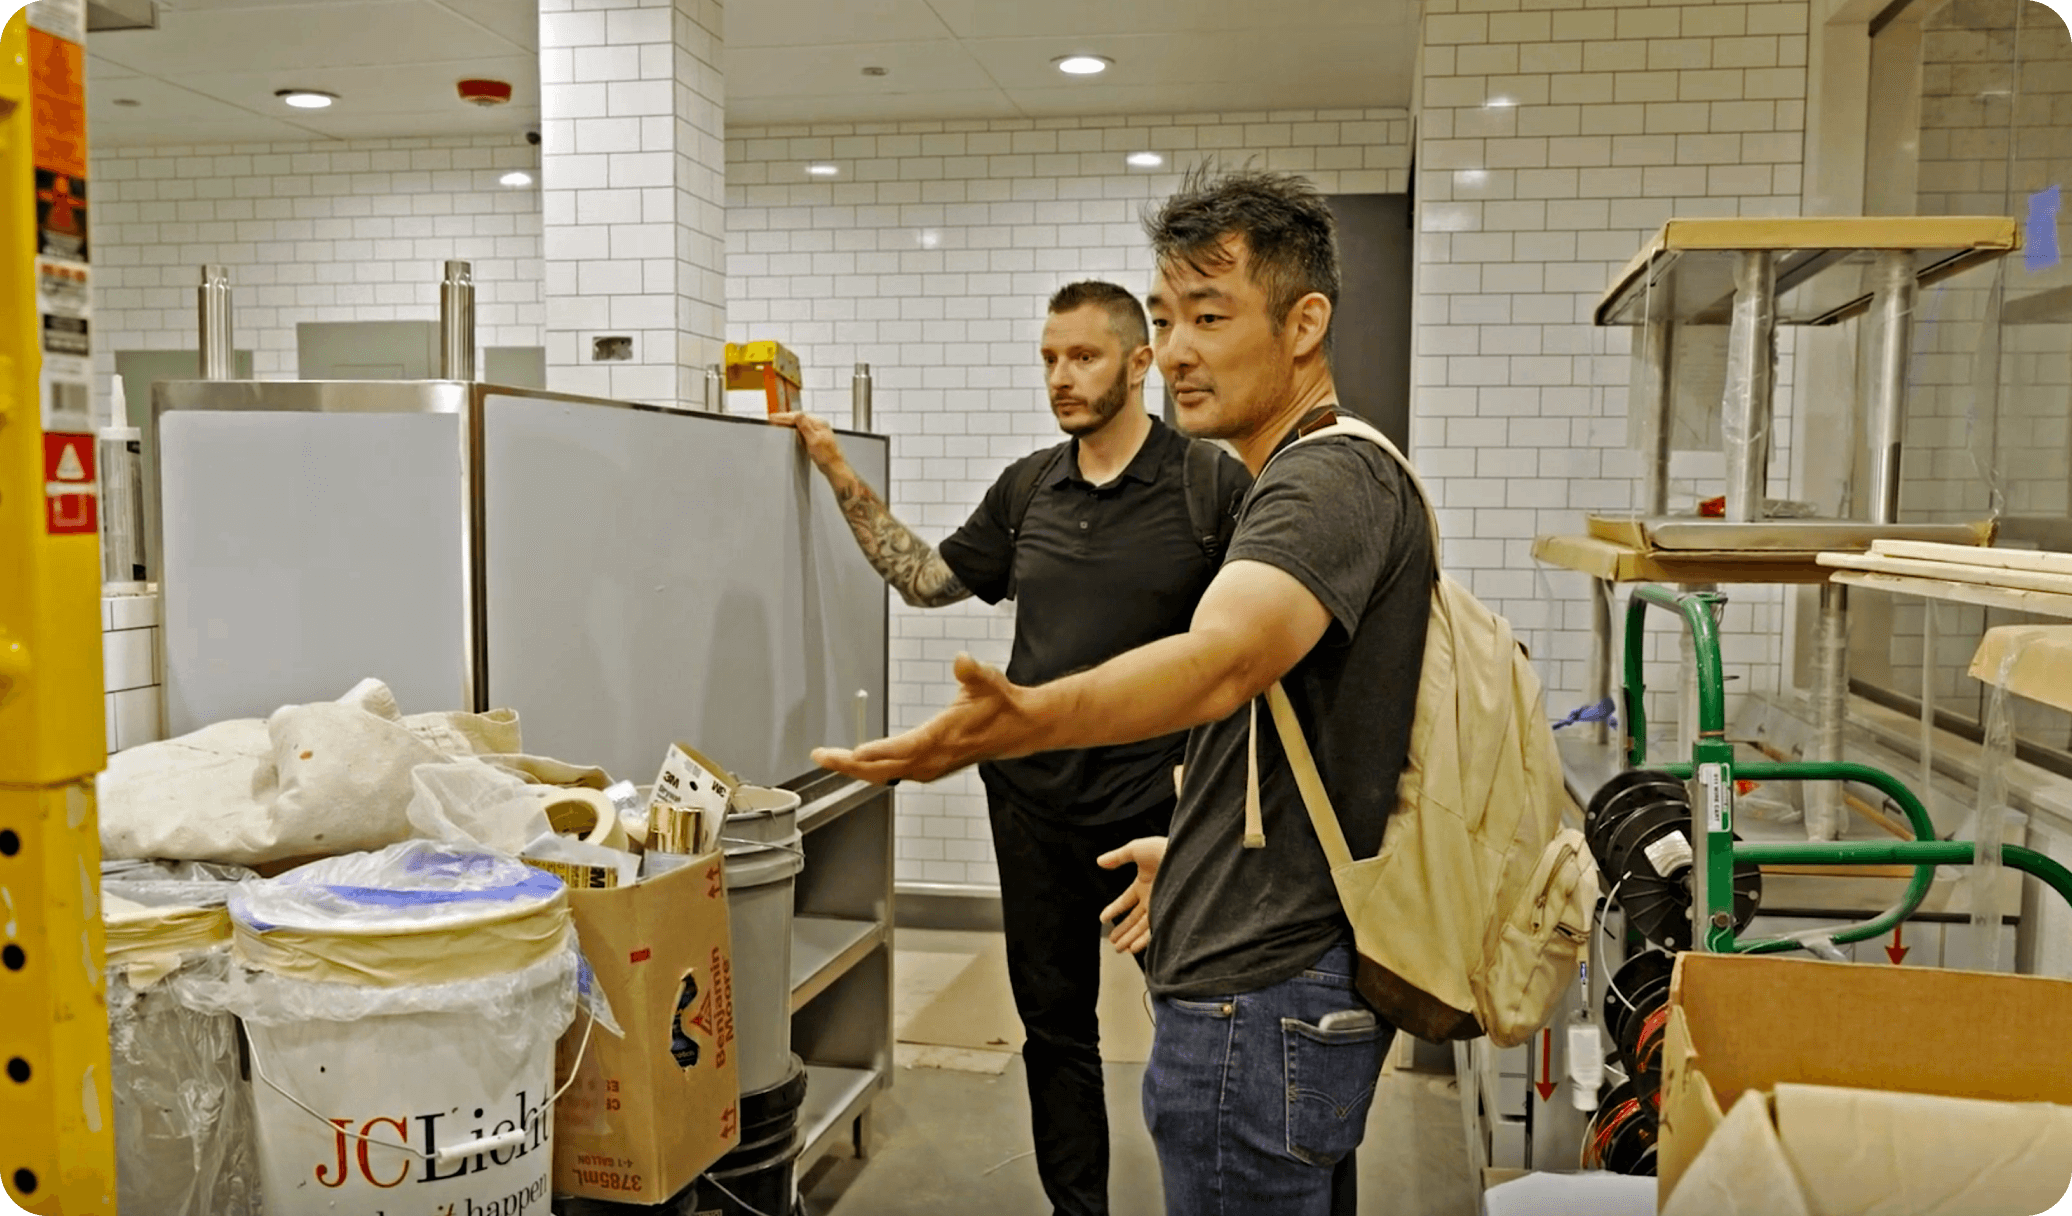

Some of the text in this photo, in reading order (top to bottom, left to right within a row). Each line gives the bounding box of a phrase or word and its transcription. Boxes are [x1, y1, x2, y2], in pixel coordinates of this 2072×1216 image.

[663, 770, 680, 789] 3M
[710, 946, 727, 1070] Benjamin
[723, 958, 734, 1043] Moore
[578, 1155, 615, 1168] GALLON
[464, 1173, 548, 1216] happen
[572, 1169, 642, 1193] 3785mL
